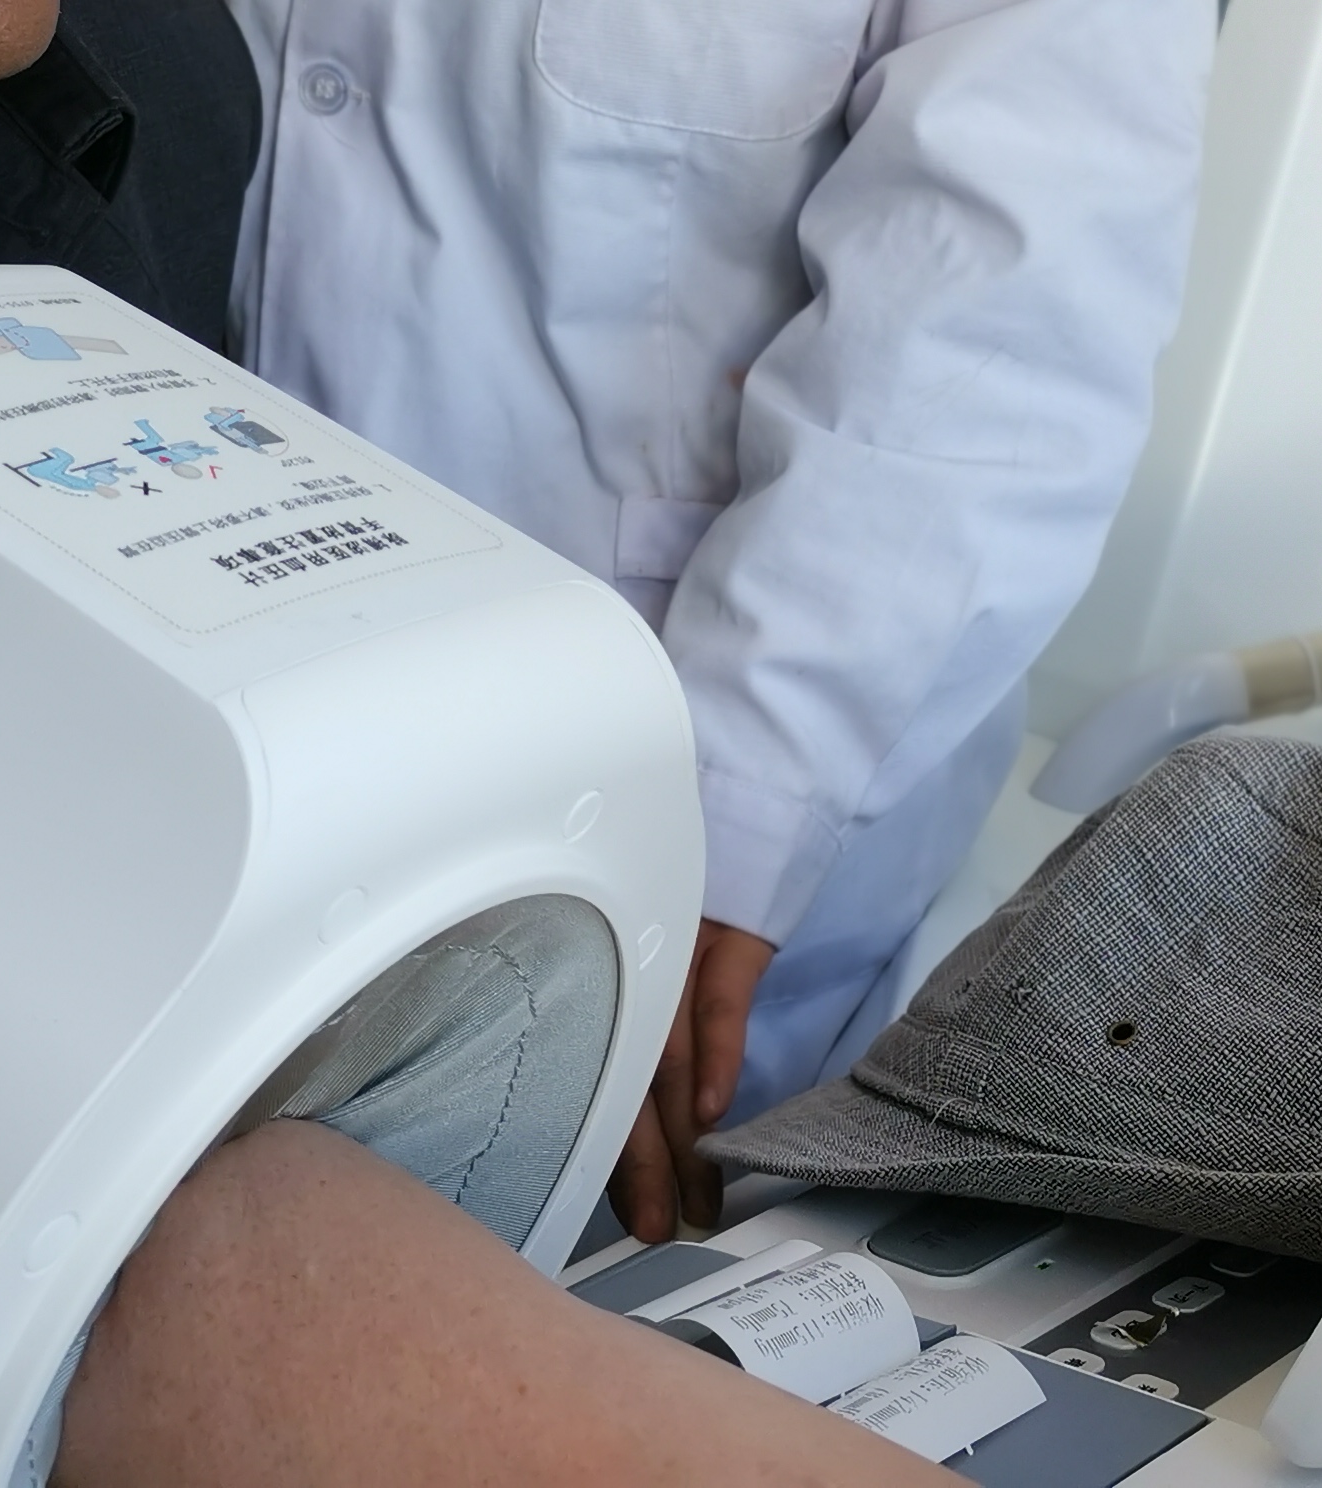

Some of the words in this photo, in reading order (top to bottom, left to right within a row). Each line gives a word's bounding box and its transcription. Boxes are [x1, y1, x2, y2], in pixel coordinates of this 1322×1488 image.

[211, 517, 384, 571] 手臂放置注意事项
[239, 532, 408, 587] 脉搏波医用血压计
